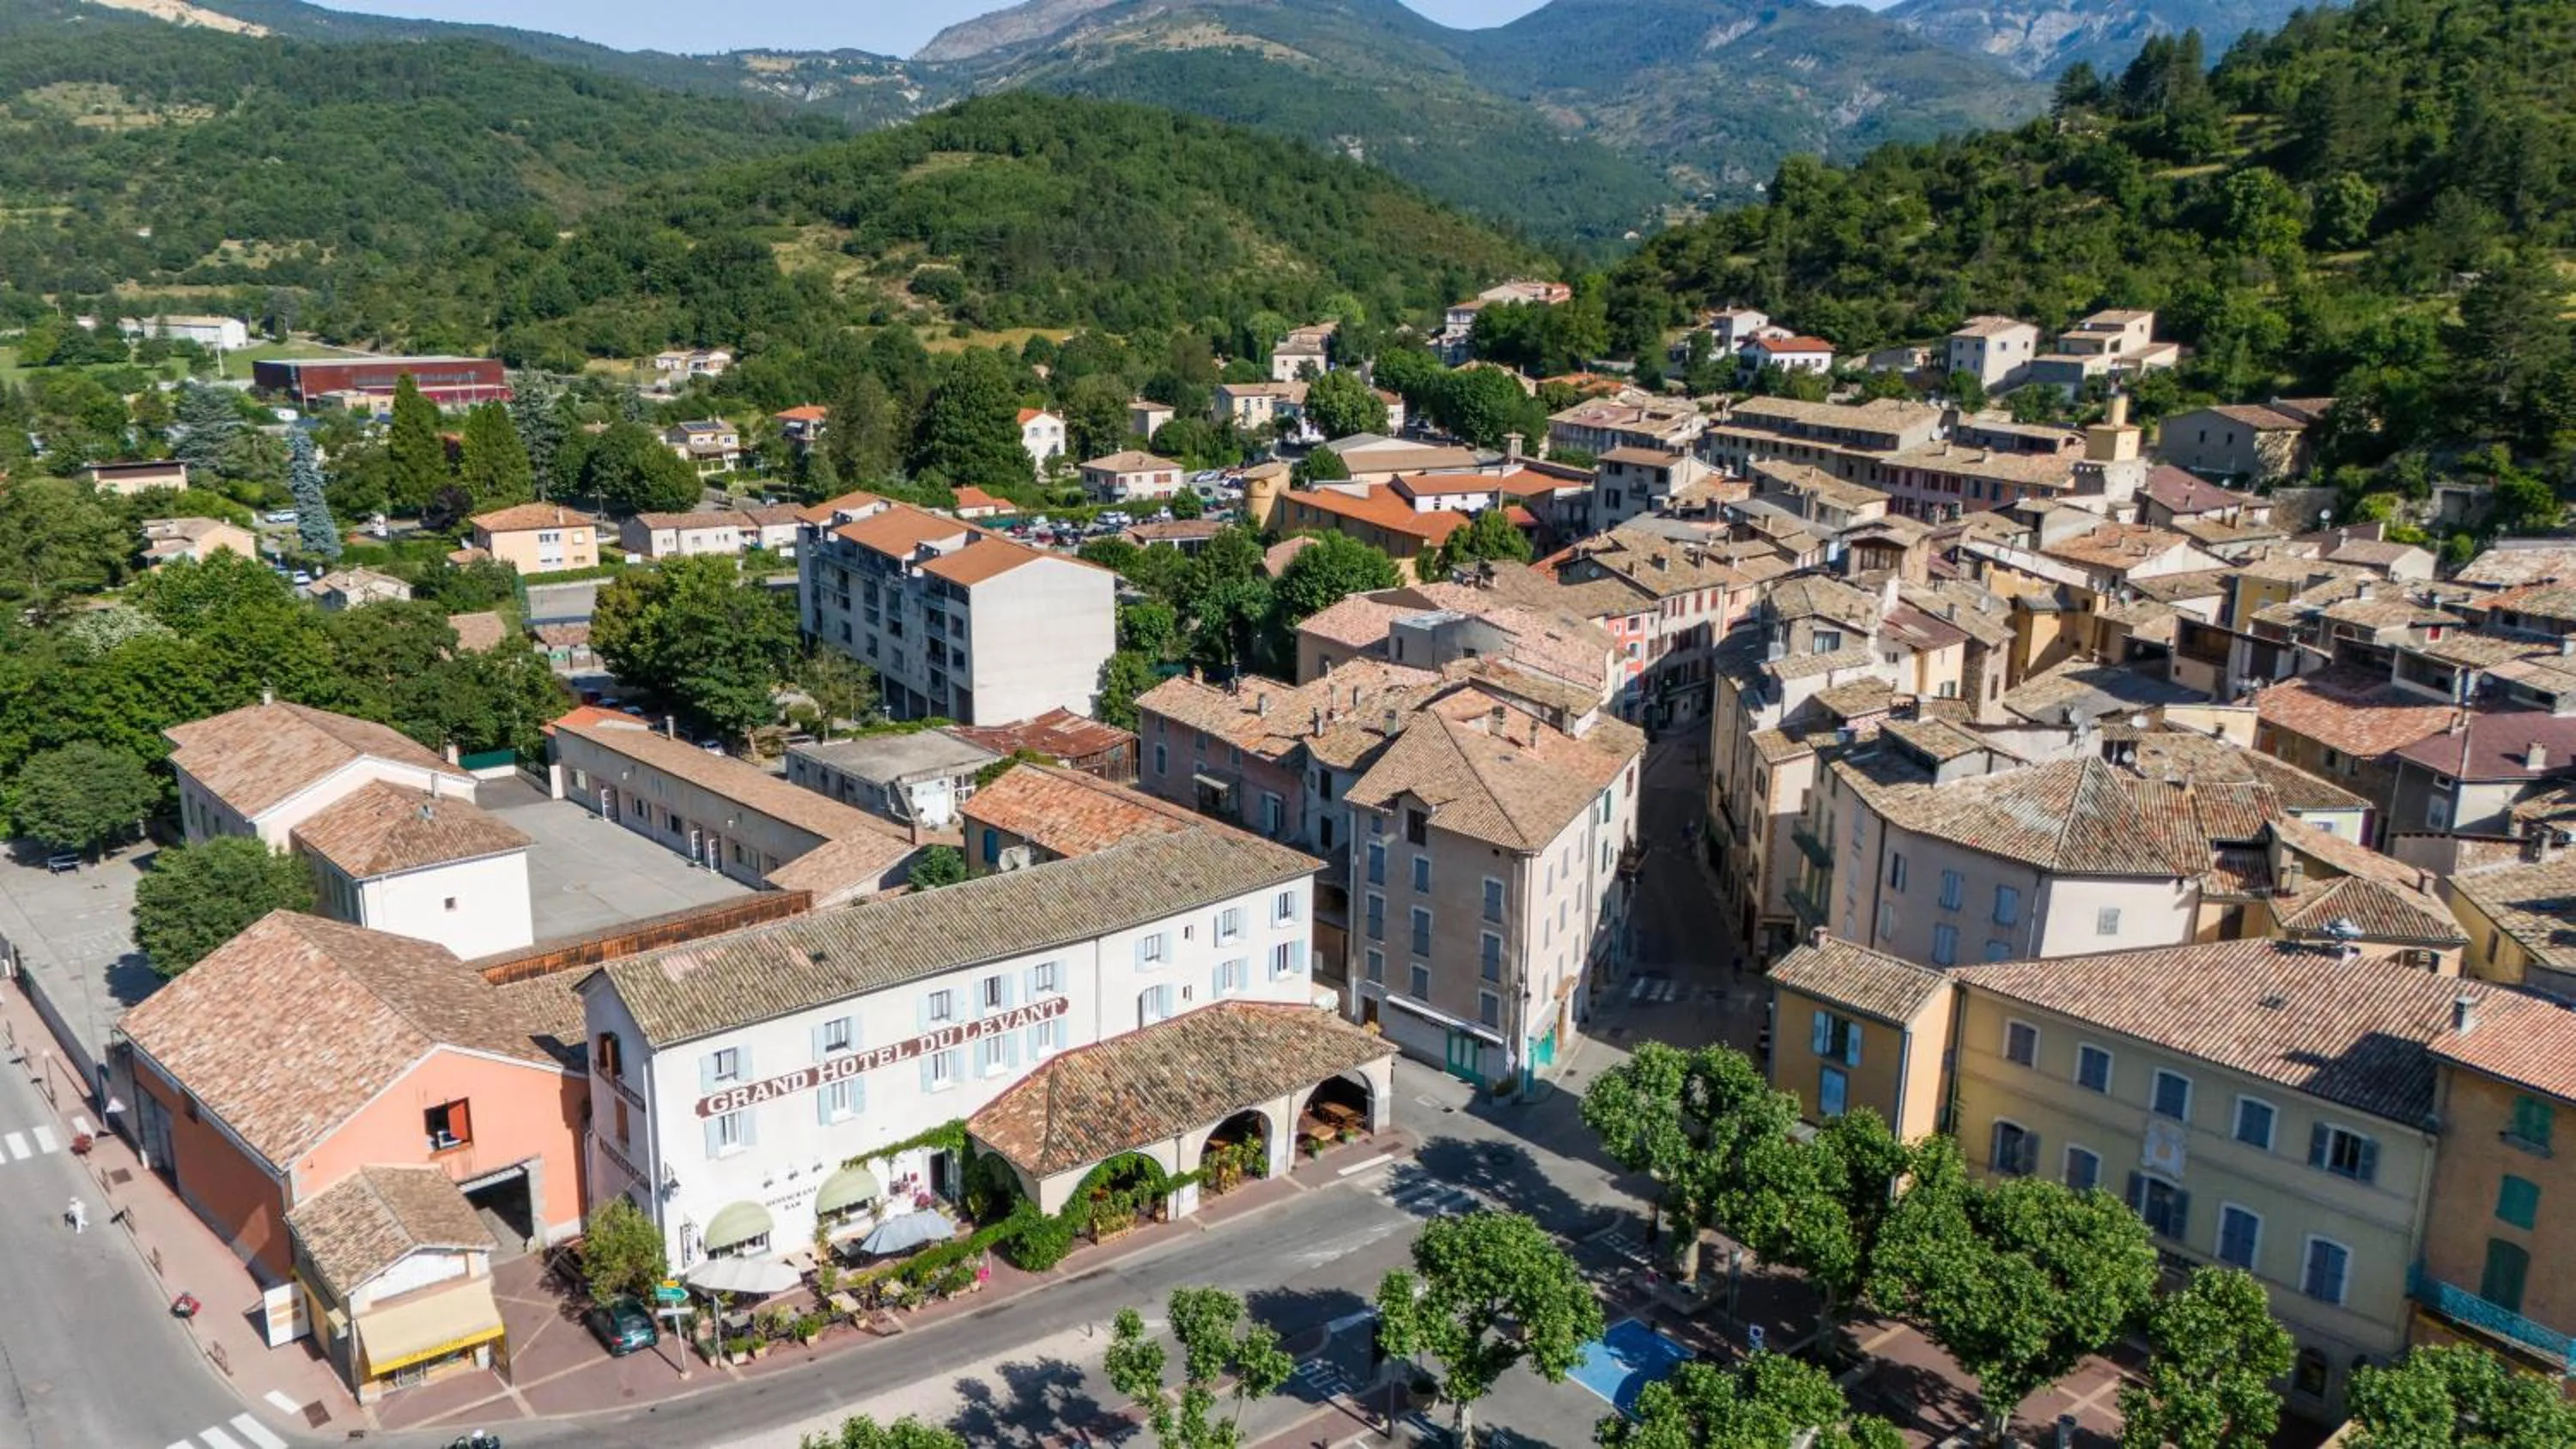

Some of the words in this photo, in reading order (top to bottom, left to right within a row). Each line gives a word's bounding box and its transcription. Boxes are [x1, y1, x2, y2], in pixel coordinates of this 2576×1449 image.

[708, 1072, 808, 1114] GRAND
[817, 1044, 911, 1084] HOTEL
[919, 1028, 955, 1054] DU
[963, 998, 1062, 1043] LEVANT
